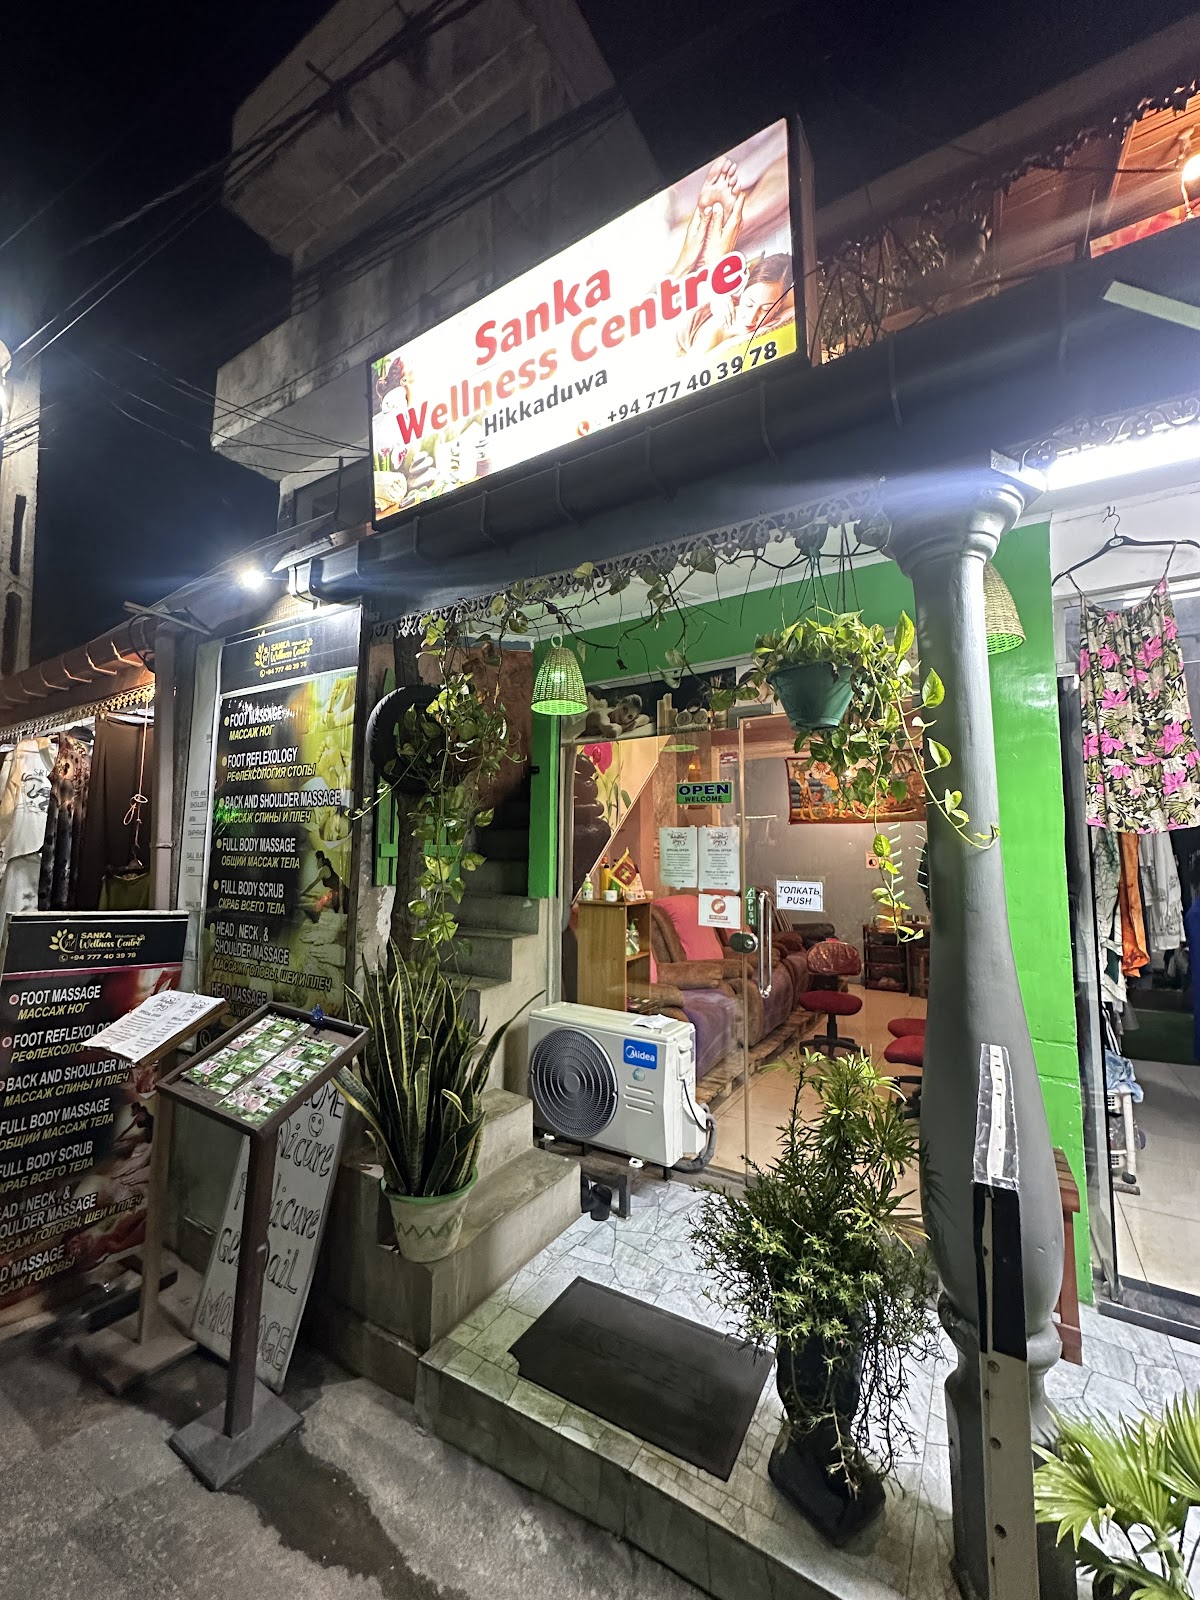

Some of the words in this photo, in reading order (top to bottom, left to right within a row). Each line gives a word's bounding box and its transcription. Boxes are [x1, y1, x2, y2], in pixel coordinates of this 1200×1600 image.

[475, 269, 611, 365] Sanka
[396, 348, 558, 445] Wellness
[570, 252, 747, 362] Centre
[607, 399, 641, 424] +94
[645, 382, 682, 409] 777
[685, 370, 712, 392] 40
[716, 356, 744, 381] 39
[749, 341, 778, 367] 78
[484, 369, 608, 436] Hikkaduwa
[229, 712, 248, 728] FOOT
[229, 726, 259, 741] МАССАЖ
[260, 724, 275, 738] НОГ
[227, 752, 246, 768] FOOT
[247, 747, 298, 767] REFLEXOLOGY
[227, 767, 286, 782] РЕФЛЕКСОЛОГИЯ
[287, 763, 316, 778] СТОПЫ
[678, 784, 729, 795] OPEN
[684, 795, 722, 803] WELCOME
[224, 795, 243, 809] BACK
[244, 794, 258, 808] AND
[259, 792, 299, 808] SHOULDER
[300, 790, 341, 806] MASSAGE
[224, 812, 254, 824] МАССАЖ
[254, 812, 281, 823] СПИНЫ
[281, 812, 289, 823] И
[289, 811, 311, 823] ПЛЕЧ
[222, 837, 238, 852] FULL
[239, 838, 258, 853] BODY
[259, 838, 296, 853] MASSAGE
[221, 854, 246, 869] ОБЩИЙ
[247, 856, 279, 869] МАССАЖ
[280, 856, 300, 869] ТЕЛА
[220, 880, 237, 895] FULL
[238, 881, 258, 897] BODY
[258, 882, 284, 898] SCRUB
[779, 885, 820, 896] ТОЛКАТЬ
[218, 898, 239, 911] СКРАБ
[240, 899, 265, 913] ВСЕГО
[266, 902, 286, 915] ТЕЛА
[786, 896, 812, 906] PUSH
[79, 938, 115, 949] Wellness
[116, 937, 141, 949] Centre
[81, 931, 112, 939] SANKA
[263, 928, 269, 942] &
[70, 953, 85, 961] +94
[214, 939, 251, 957] SHOULDER
[251, 946, 289, 965] MASSAGE
[213, 958, 244, 975] МАССАЖ
[280, 970, 298, 984] ШЕИ
[298, 973, 305, 985] И
[305, 975, 332, 991] ПЛЕЧ
[20, 990, 50, 1006] FOOT
[52, 985, 101, 1003] MASSAGE
[211, 982, 231, 1000] HEAD
[231, 986, 268, 1007] MASSAGE
[17, 1004, 67, 1020] МАССАЖ
[68, 1002, 90, 1015] НОГ
[12, 1031, 47, 1048] FOOT
[631, 1049, 655, 1062] Midea
[6, 1074, 38, 1092] BACK
[41, 1070, 62, 1086] AND
[63, 1059, 116, 1081] SHOULDER
[3, 1087, 54, 1108] МАССАЖ
[55, 1080, 93, 1096] СПИНЫ
[96, 1078, 104, 1088] И
[105, 1071, 130, 1086] ПЛЕЧ
[0, 1117, 27, 1136] FULL
[30, 1107, 61, 1128] BODY
[61, 1098, 110, 1121] MASSAGE
[0, 1129, 40, 1151] ОБЩИЙ
[41, 1121, 87, 1142] МАССАЖ
[90, 1113, 114, 1128] ТЕЛА
[26, 1150, 57, 1172] BODY
[58, 1140, 93, 1162] SCRUB
[30, 1167, 66, 1186] ВСЕГО
[68, 1156, 94, 1172] ТЕЛА
[63, 1185, 71, 1200] &
[46, 1193, 97, 1223] MASSAGE
[84, 1209, 106, 1225] ШЕИ
[107, 1206, 116, 1217] И
[116, 1194, 144, 1213] ПЛЕЧ
[11, 1245, 65, 1276] MASSAGE
[28, 1257, 75, 1282] ГОЛОВЫ
